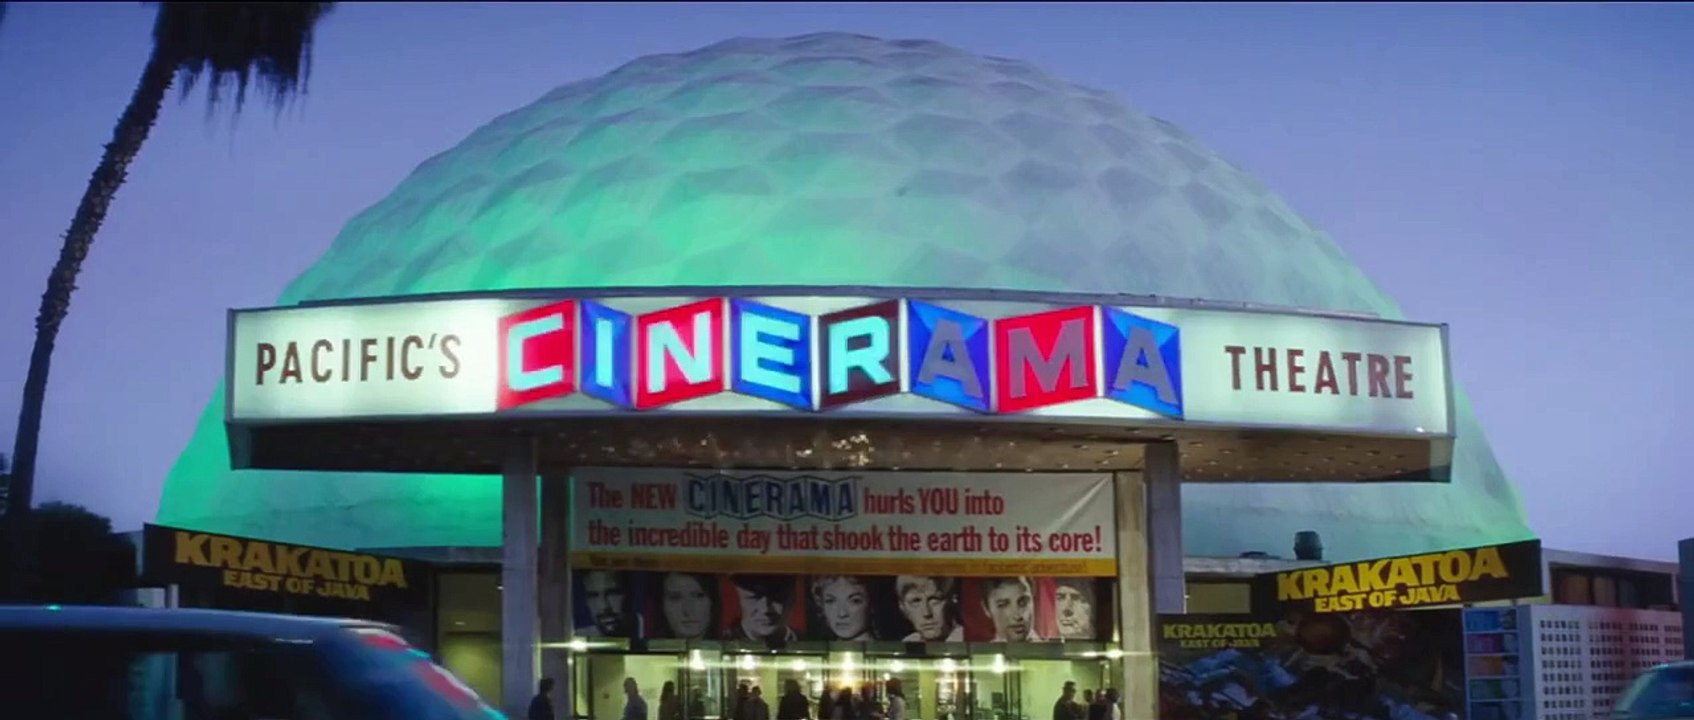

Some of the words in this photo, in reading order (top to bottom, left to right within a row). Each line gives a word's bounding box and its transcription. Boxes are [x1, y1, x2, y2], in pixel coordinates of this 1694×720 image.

[255, 333, 462, 386] PACIFIC'S
[506, 312, 1180, 403] CINERAMA
[1224, 346, 1414, 399] THEATRE
[587, 481, 623, 509] The
[630, 482, 677, 510] NEW
[687, 479, 855, 516] CINERAMA
[863, 487, 915, 515] hurls
[918, 487, 960, 515] YOU
[964, 488, 1005, 515] into
[588, 520, 622, 546] the
[628, 520, 730, 548] incredible
[736, 523, 771, 554] day
[776, 523, 819, 551] that
[823, 524, 883, 551] shook
[887, 525, 921, 551] the
[926, 525, 982, 552] earth
[987, 527, 1010, 552] to
[1016, 525, 1043, 552] its
[1047, 525, 1103, 552] core!
[174, 531, 409, 589] KRAKATOA
[1276, 547, 1509, 601] KRAKATOA
[223, 569, 280, 592] EAST
[285, 576, 316, 595] OF
[317, 580, 370, 601] JAVA
[1314, 594, 1370, 613] EAST
[1370, 590, 1400, 609] OF
[1400, 583, 1462, 604] JAVA
[1162, 622, 1278, 639] KRAKATOA
